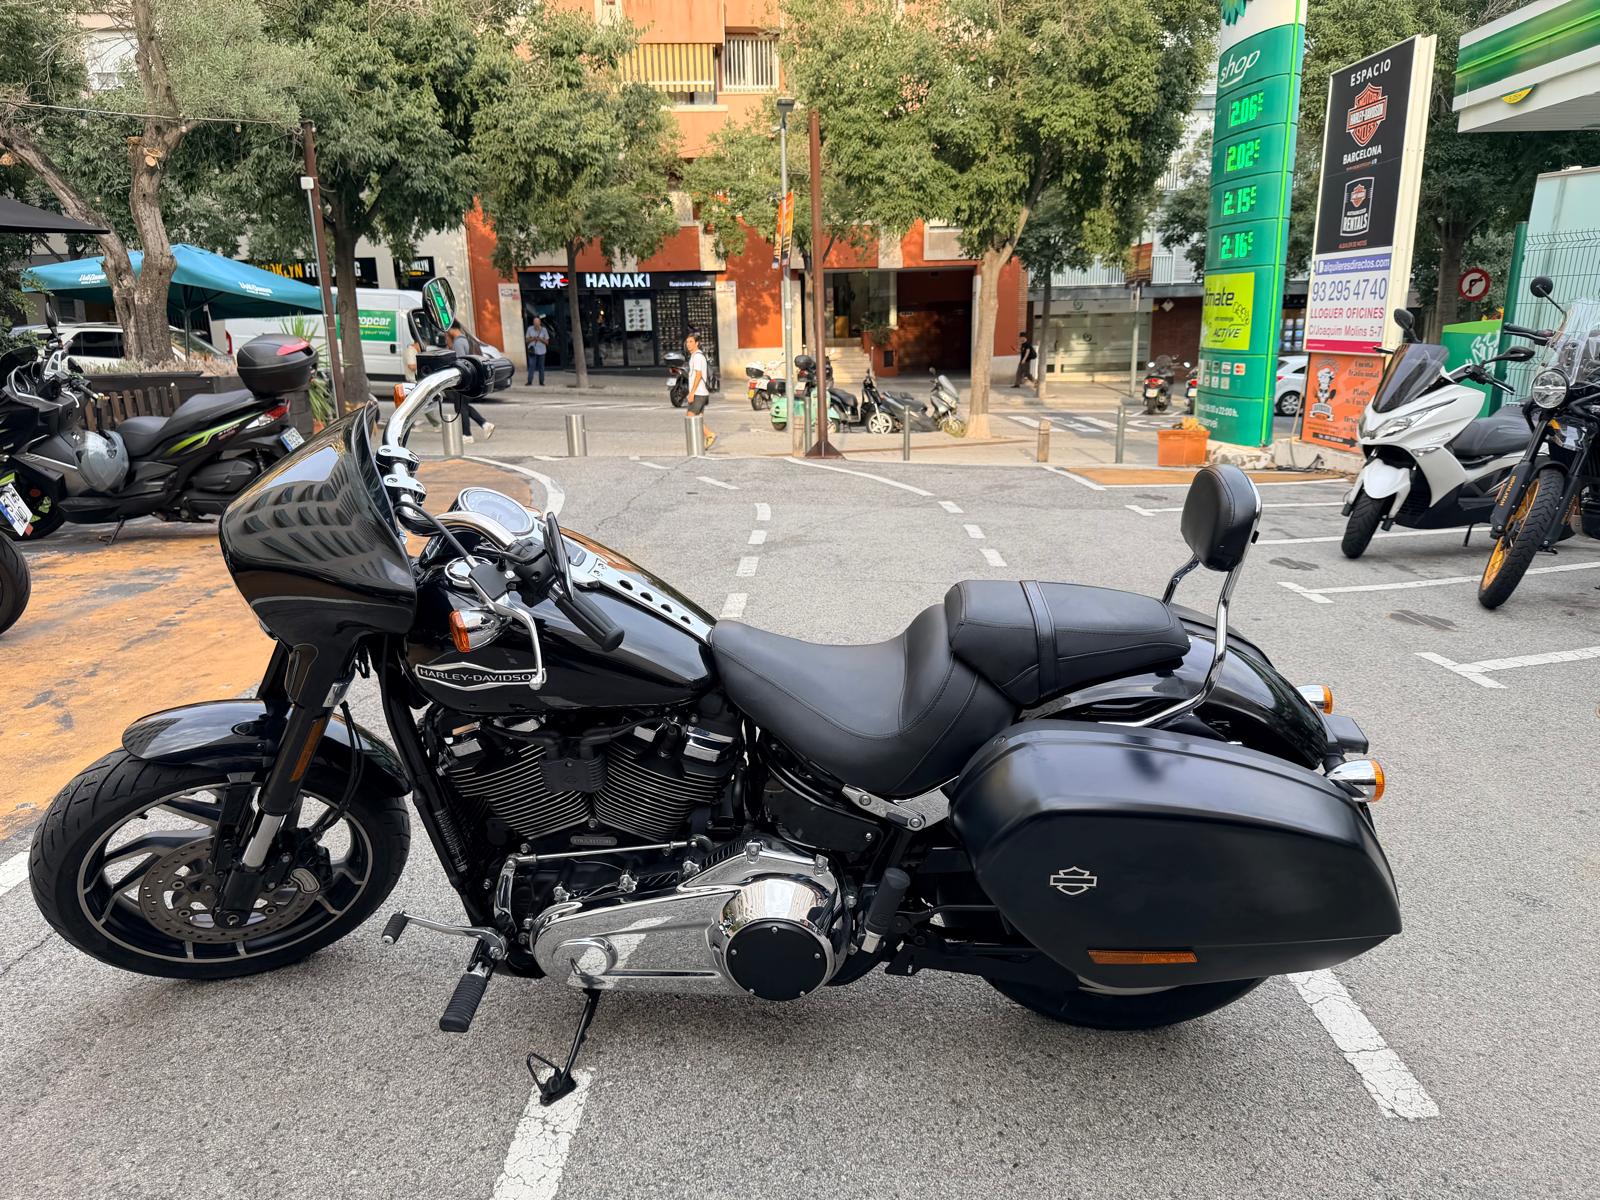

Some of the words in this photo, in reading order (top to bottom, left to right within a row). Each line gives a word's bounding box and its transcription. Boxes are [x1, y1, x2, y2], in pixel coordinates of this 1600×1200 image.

[1219, 50, 1260, 88] shop
[1350, 59, 1391, 87] ESPACIO
[1342, 144, 1382, 165] BARCELONA
[1342, 212, 1369, 232] RENTALS
[586, 273, 650, 288] HANAKI
[1312, 282, 1326, 302] 93
[1328, 280, 1350, 301] 295
[358, 316, 391, 327] opcar
[1311, 308, 1343, 319] LLOGUER
[1346, 308, 1384, 319] OFICINES
[1214, 327, 1241, 338] ACTIVE
[1344, 325, 1368, 336] Molins
[1369, 326, 1383, 337] 5-7
